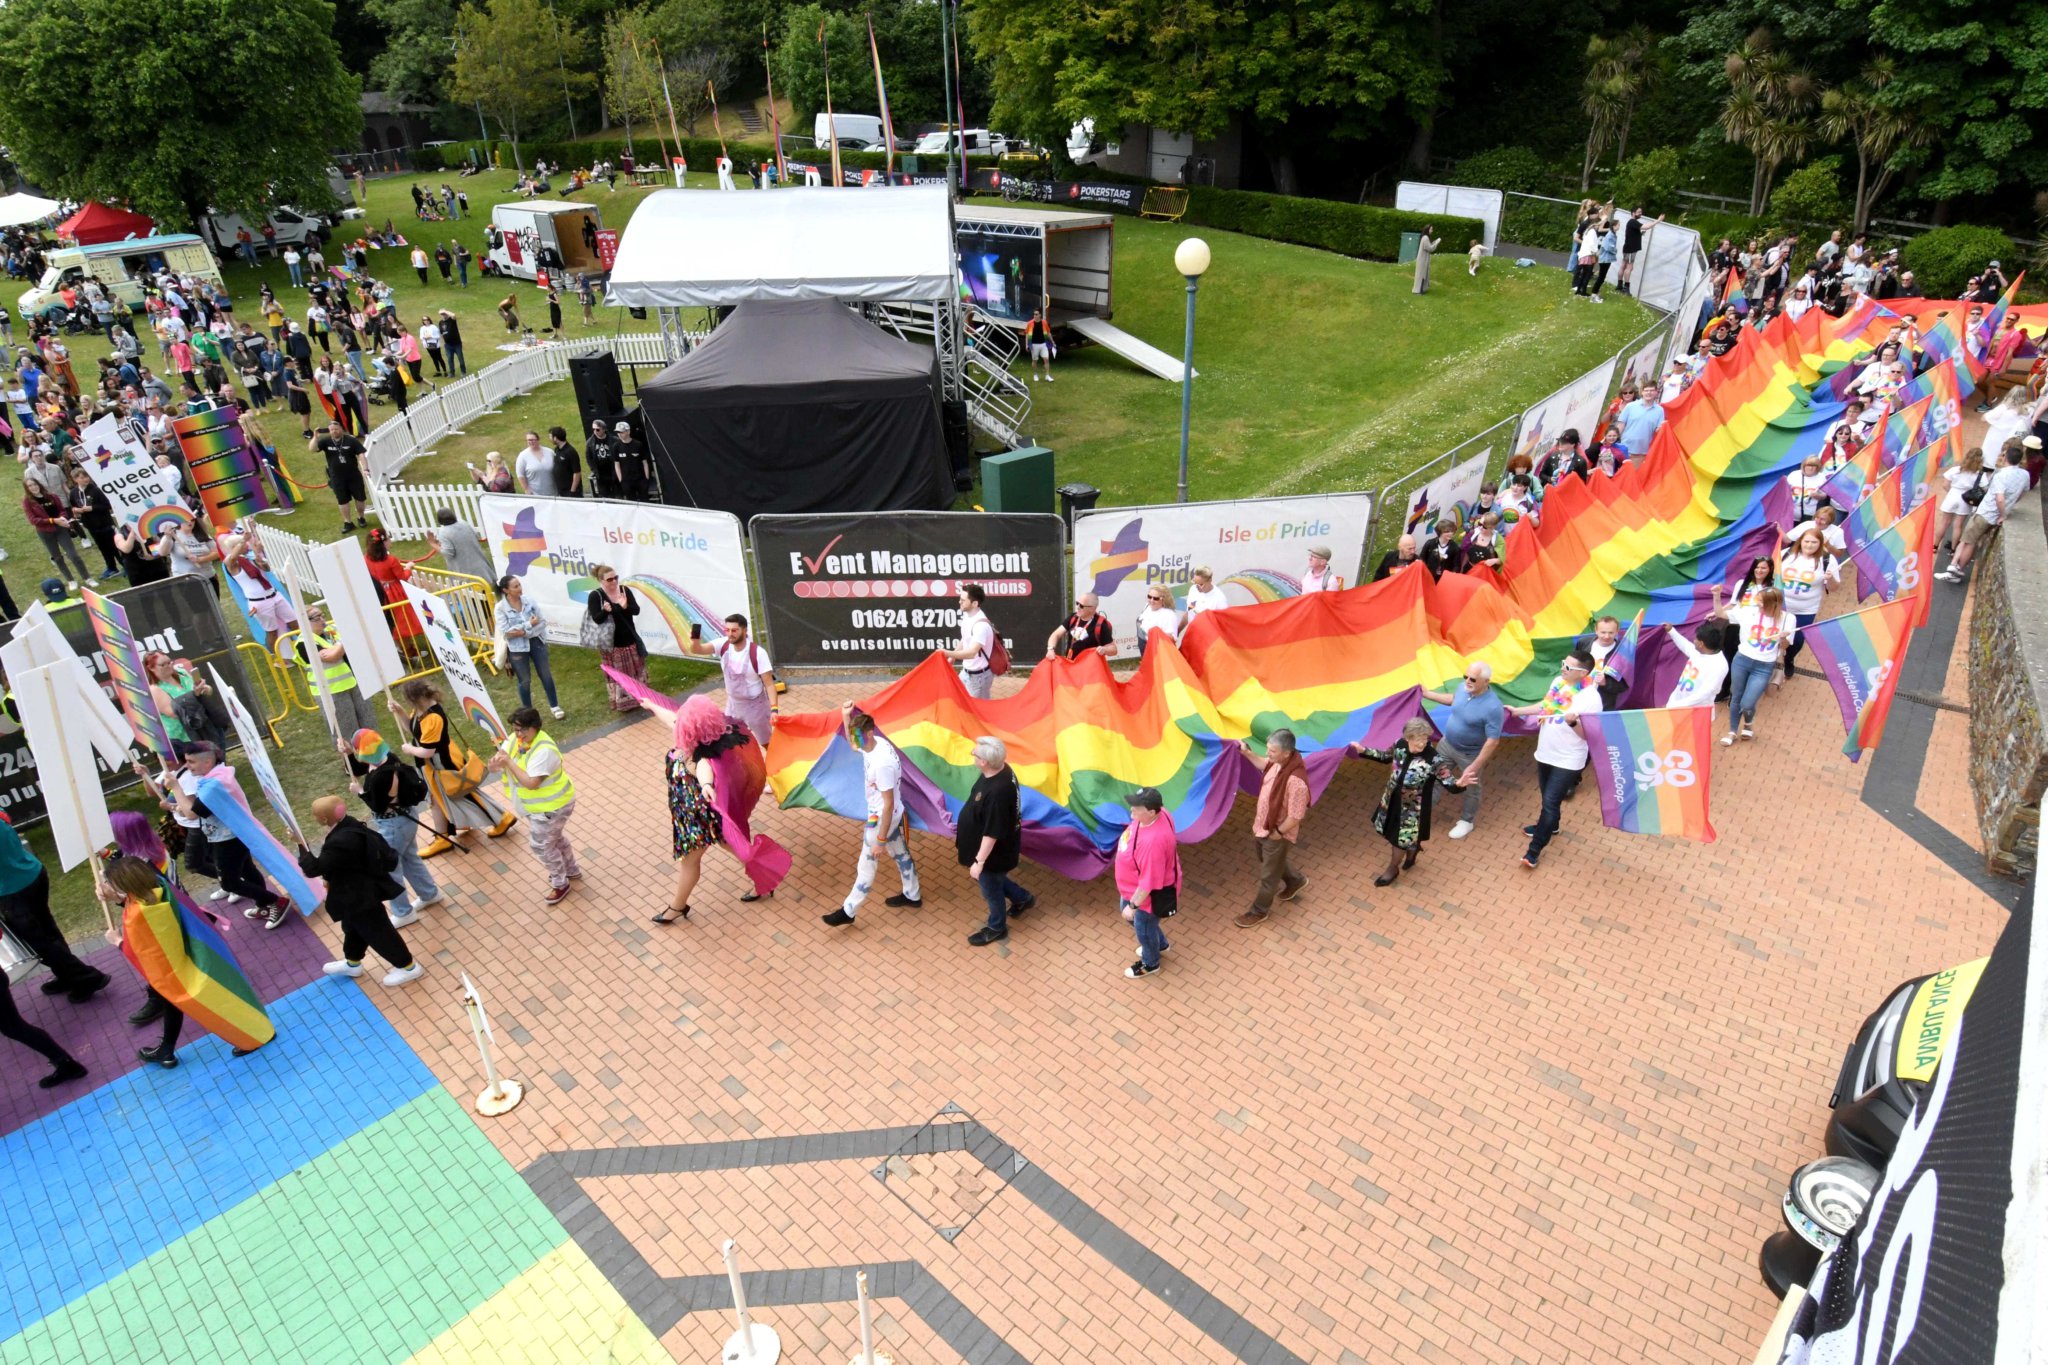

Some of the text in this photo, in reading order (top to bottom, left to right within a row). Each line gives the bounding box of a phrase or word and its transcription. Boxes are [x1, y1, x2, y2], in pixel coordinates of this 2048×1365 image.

[1080, 186, 1131, 199] POKERSTARS
[101, 464, 158, 495] queer
[119, 482, 164, 507] fella
[603, 526, 708, 551] Isle of Pride
[1218, 519, 1331, 544] Isle of Pride
[559, 545, 579, 559] Isle
[871, 550, 1031, 576] Management
[1161, 554, 1183, 567] Isle
[852, 608, 964, 628] 01624 82703
